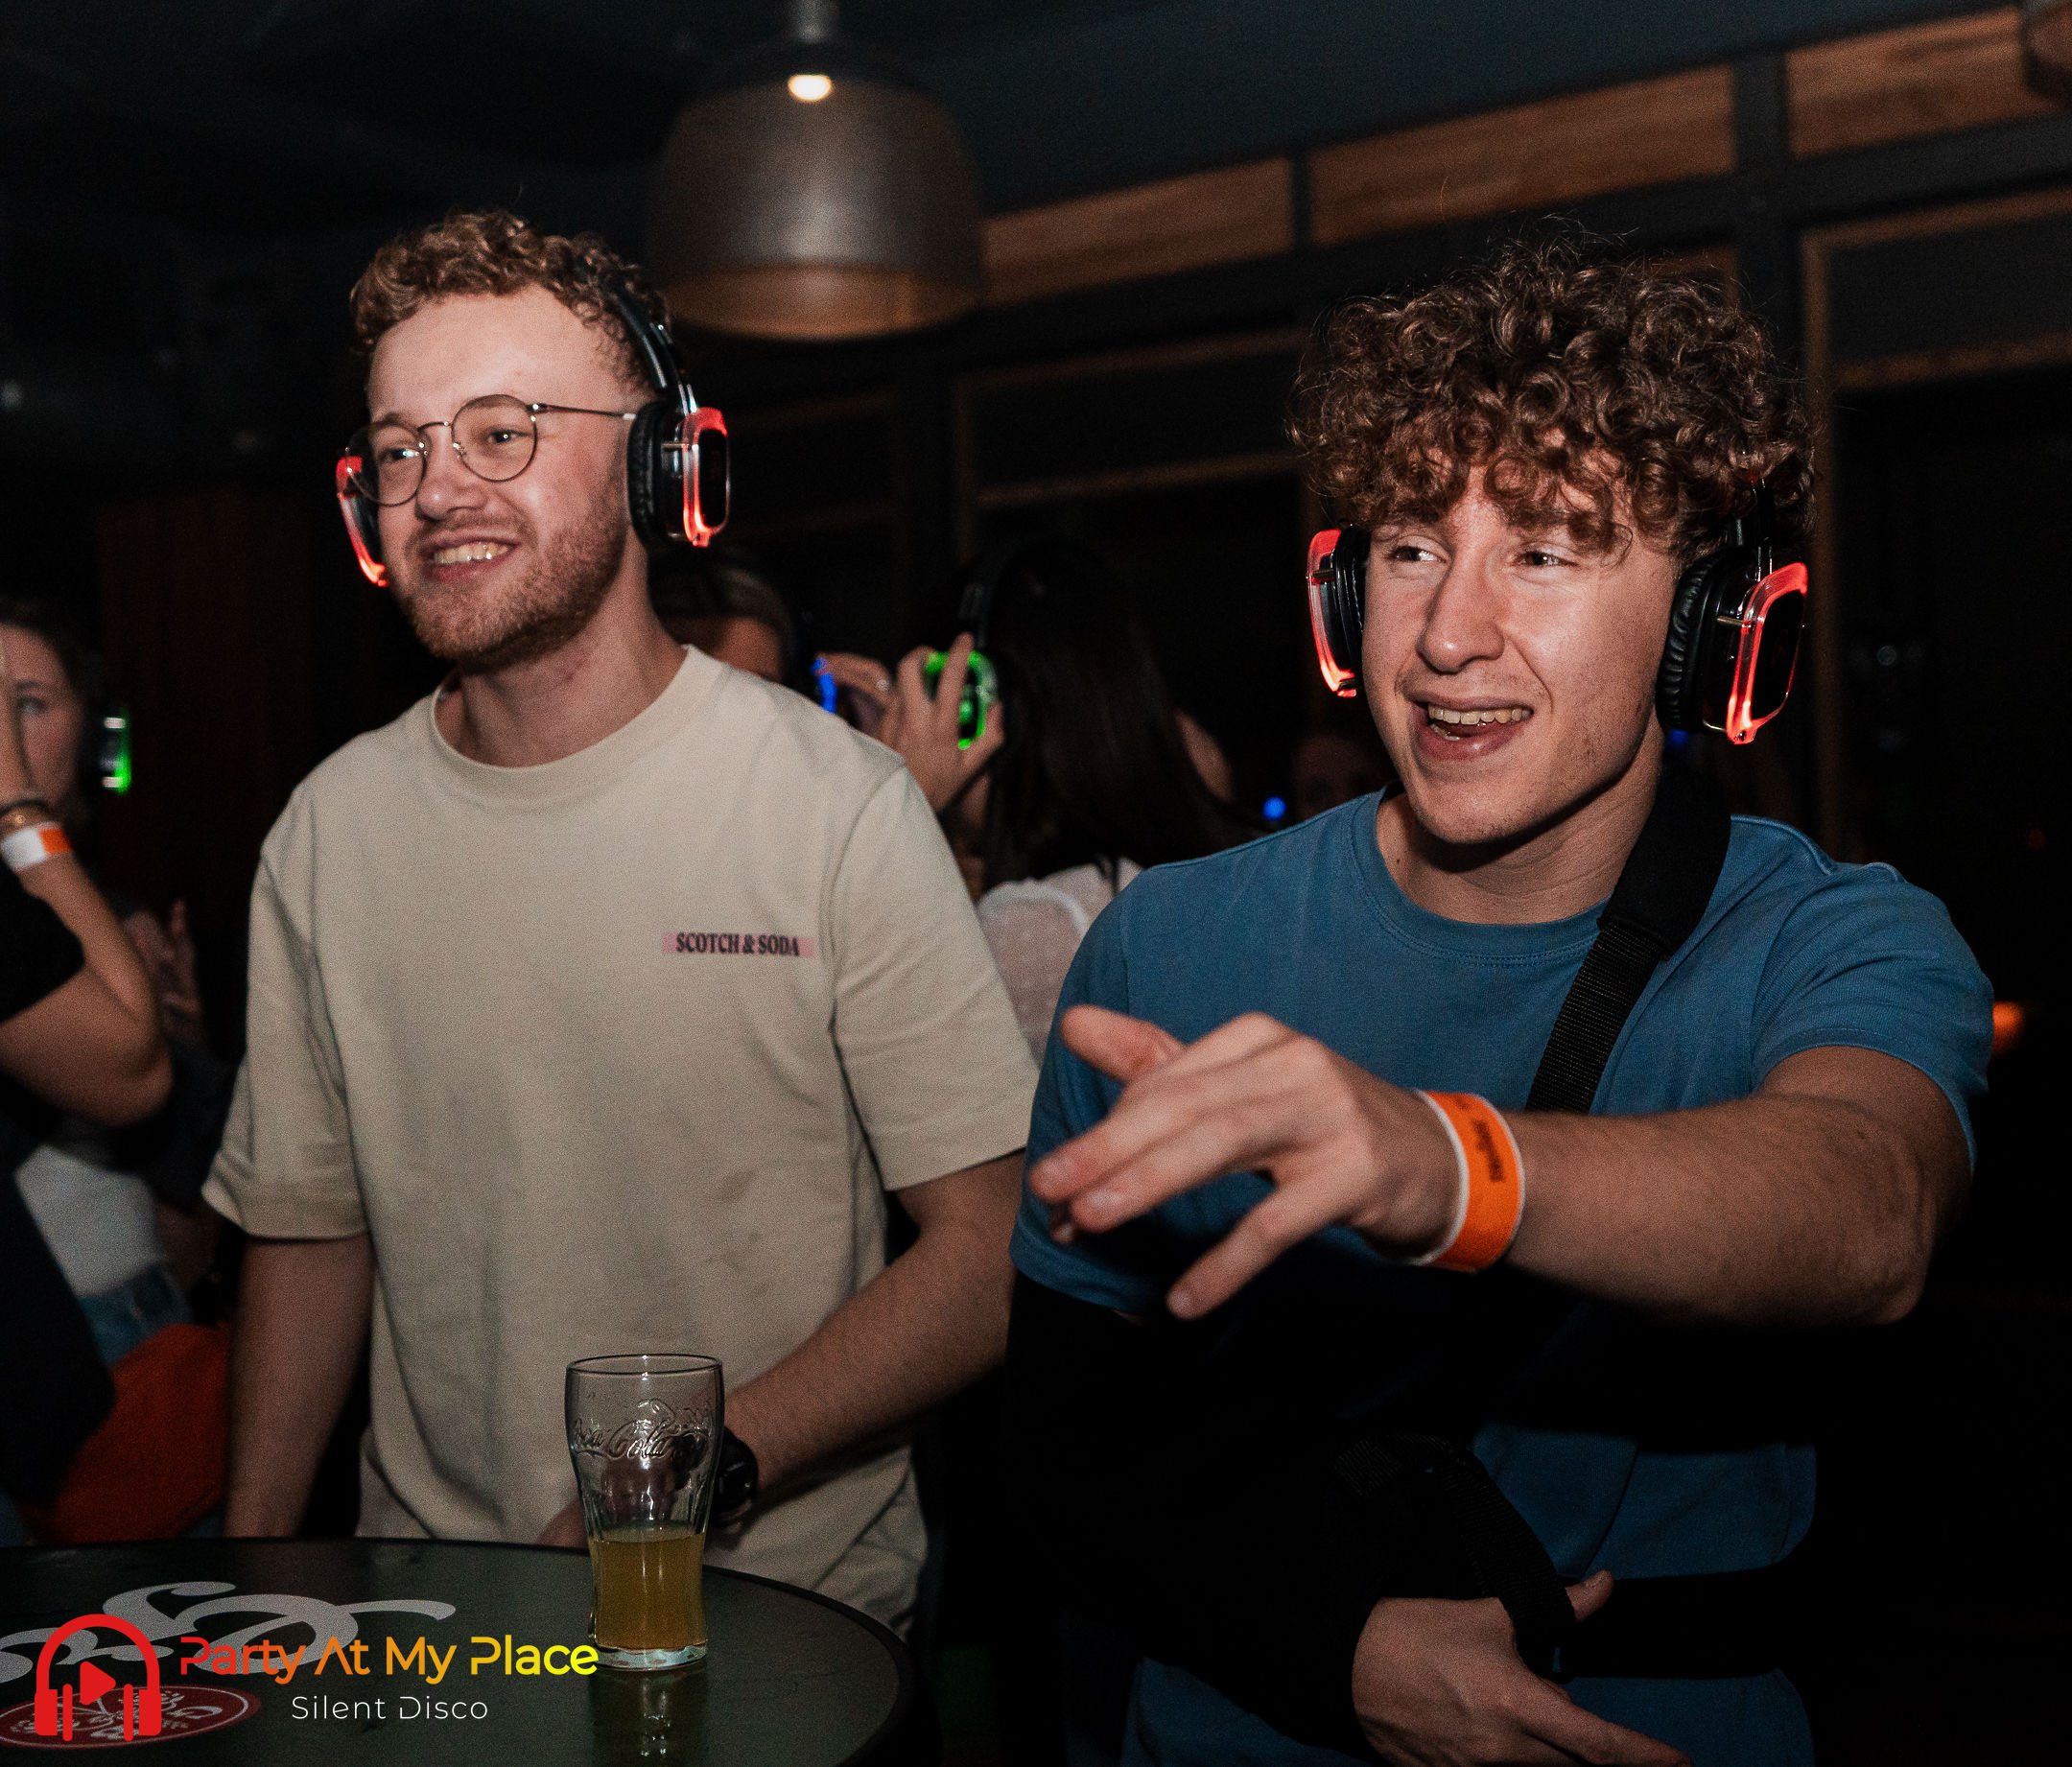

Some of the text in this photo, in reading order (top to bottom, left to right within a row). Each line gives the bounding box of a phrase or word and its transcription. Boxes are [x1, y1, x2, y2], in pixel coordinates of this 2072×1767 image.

[675, 931, 800, 957] SCOTCH & SODA
